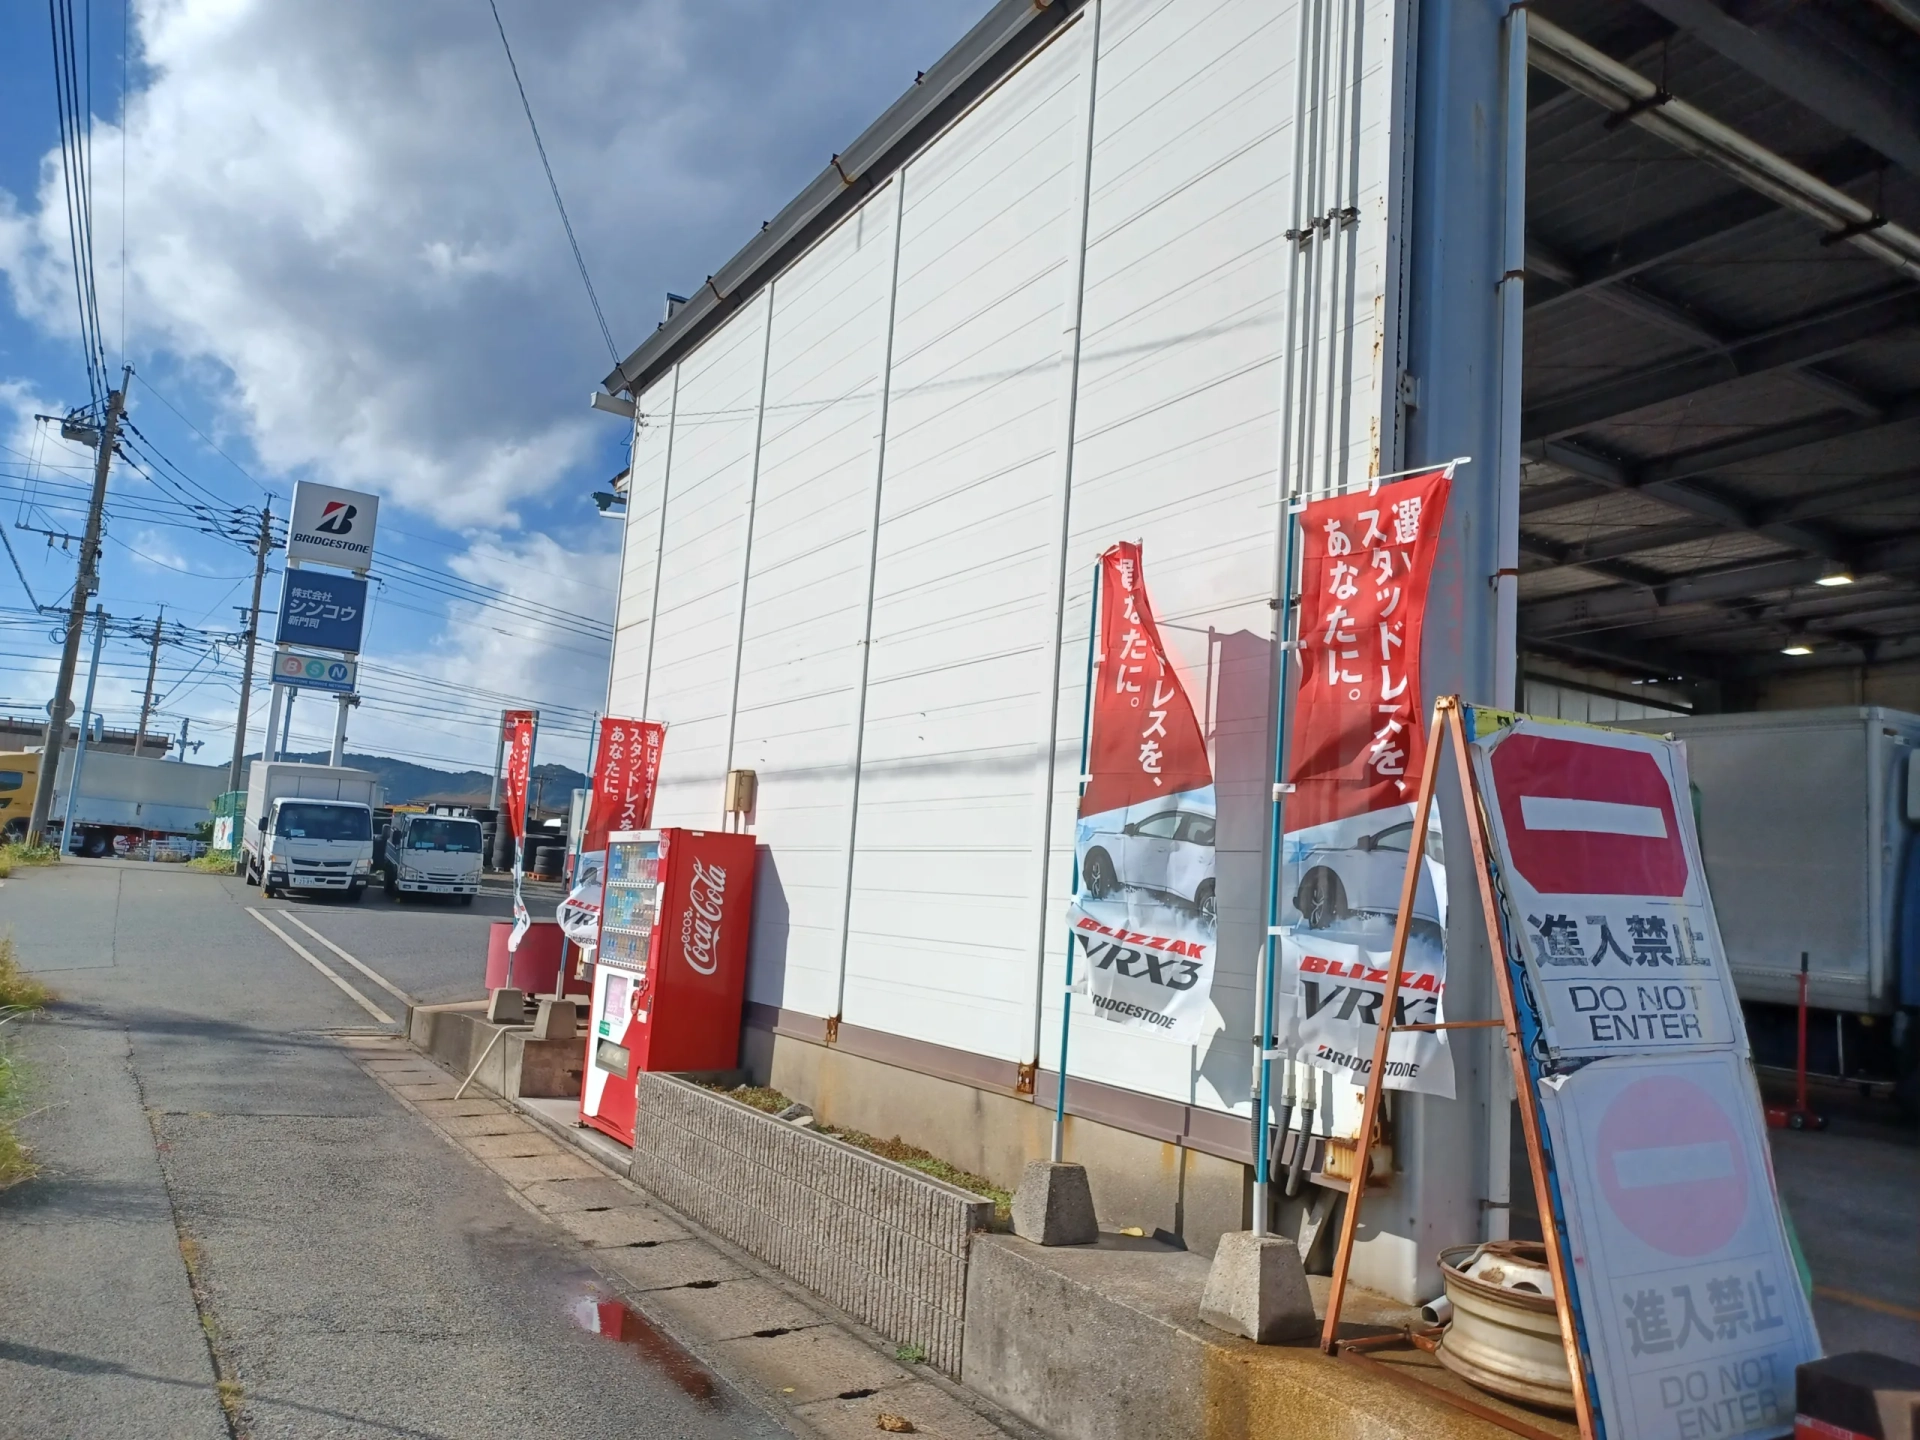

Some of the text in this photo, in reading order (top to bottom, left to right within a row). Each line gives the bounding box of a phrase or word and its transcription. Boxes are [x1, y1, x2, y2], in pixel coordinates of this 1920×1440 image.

[294, 533, 370, 554] BRIDGESTONE
[289, 599, 357, 622] シンコウ
[291, 587, 333, 603] 株式会社
[1323, 517, 1363, 701] あなたに。
[288, 615, 320, 629] 新門司
[603, 726, 625, 801] あなたに。
[566, 898, 601, 913] BLIZ
[683, 855, 727, 975] Coca-Cola
[1076, 917, 1207, 960] BLIZZAK
[1526, 913, 1712, 969] 進入禁止
[1075, 933, 1204, 991] VRX3
[1091, 992, 1177, 1030] RIDGESTONE
[1568, 985, 1627, 1012] DO
[1637, 985, 1702, 1011] NOT
[1589, 1013, 1703, 1041] ENTER
[1316, 1044, 1420, 1078] BRIDGSTONE
[1622, 1268, 1784, 1358] 進入禁止
[1660, 1352, 1778, 1410] DO NOT
[1676, 1388, 1778, 1440] ENTER
